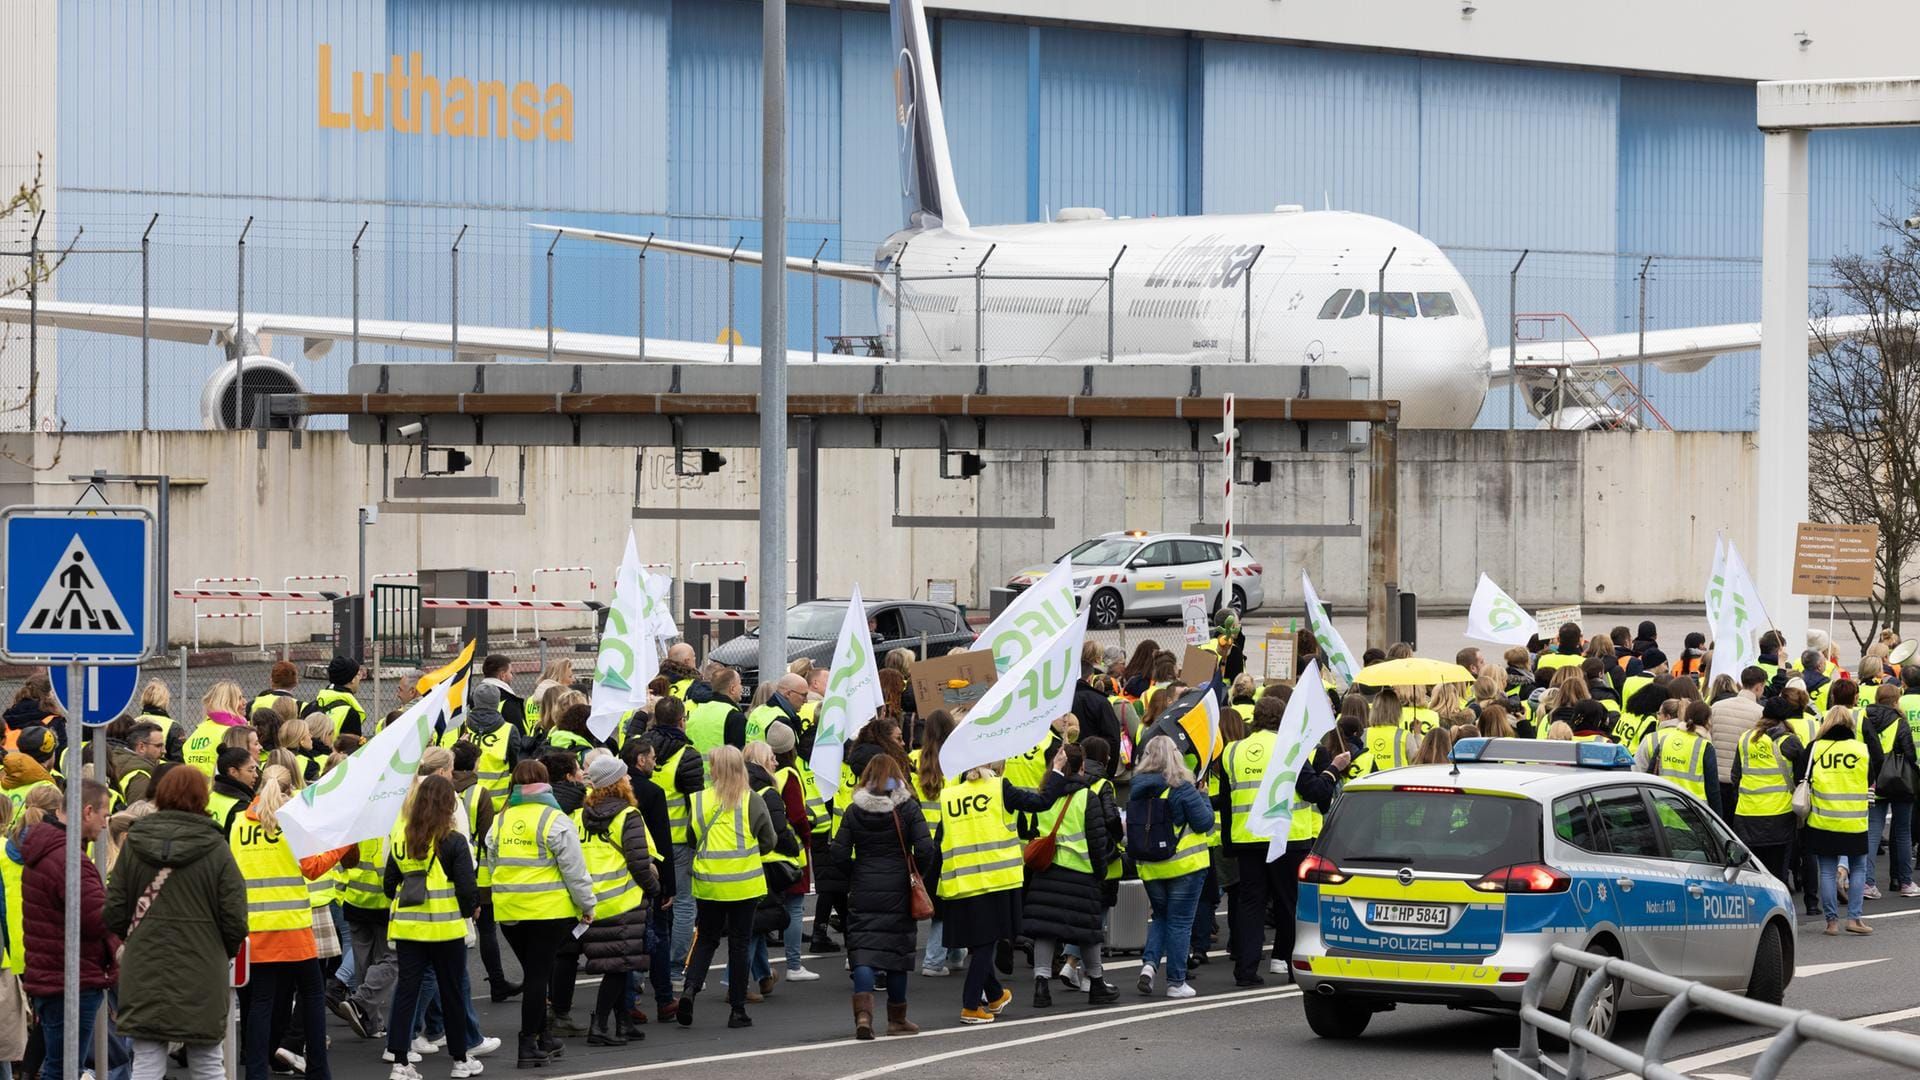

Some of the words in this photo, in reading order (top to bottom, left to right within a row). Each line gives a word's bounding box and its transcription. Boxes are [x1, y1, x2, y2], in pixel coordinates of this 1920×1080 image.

[1616, 720, 1636, 740] UFO
[191, 737, 211, 750] UFO
[1820, 753, 1860, 770] UFO
[1244, 767, 1263, 775] Crew
[947, 794, 992, 818] UFO
[503, 838, 513, 846] LH
[514, 838, 533, 847] Crew
[1330, 906, 1346, 914] Notruf
[1646, 899, 1665, 914] Notruf
[1666, 899, 1676, 913] 110
[1703, 895, 1745, 919] POLIZEI
[1375, 905, 1389, 920] WI
[1399, 907, 1414, 922] HP
[1416, 908, 1446, 924] 5841
[1330, 916, 1350, 930] 110
[1379, 936, 1433, 951] POLIZEI
